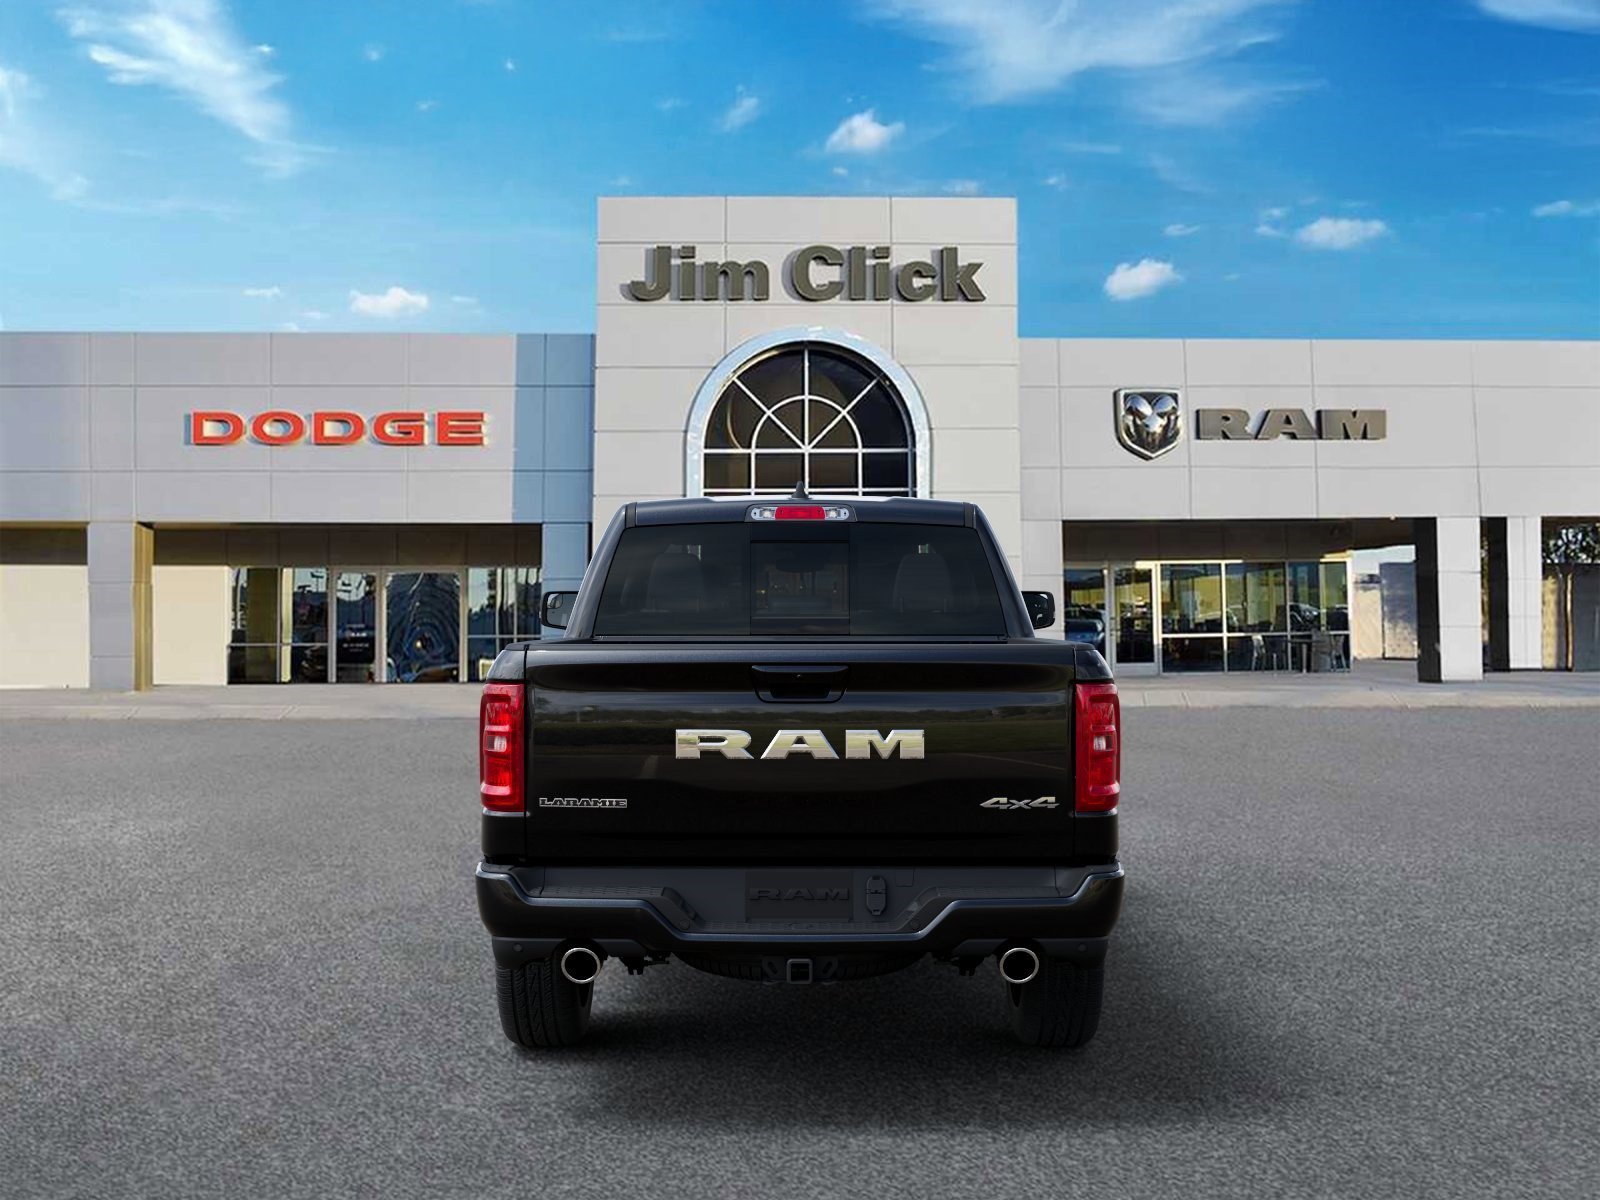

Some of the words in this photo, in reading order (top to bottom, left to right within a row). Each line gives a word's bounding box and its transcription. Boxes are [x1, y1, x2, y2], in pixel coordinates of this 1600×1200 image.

[627, 244, 770, 302] Jim
[791, 244, 986, 302] Click
[190, 410, 486, 447] DODGE
[1196, 407, 1387, 441] RAM
[675, 729, 925, 760] RAM
[539, 797, 628, 809] LARAMIE
[980, 796, 1060, 810] 4x4
[750, 887, 850, 901] RAM
